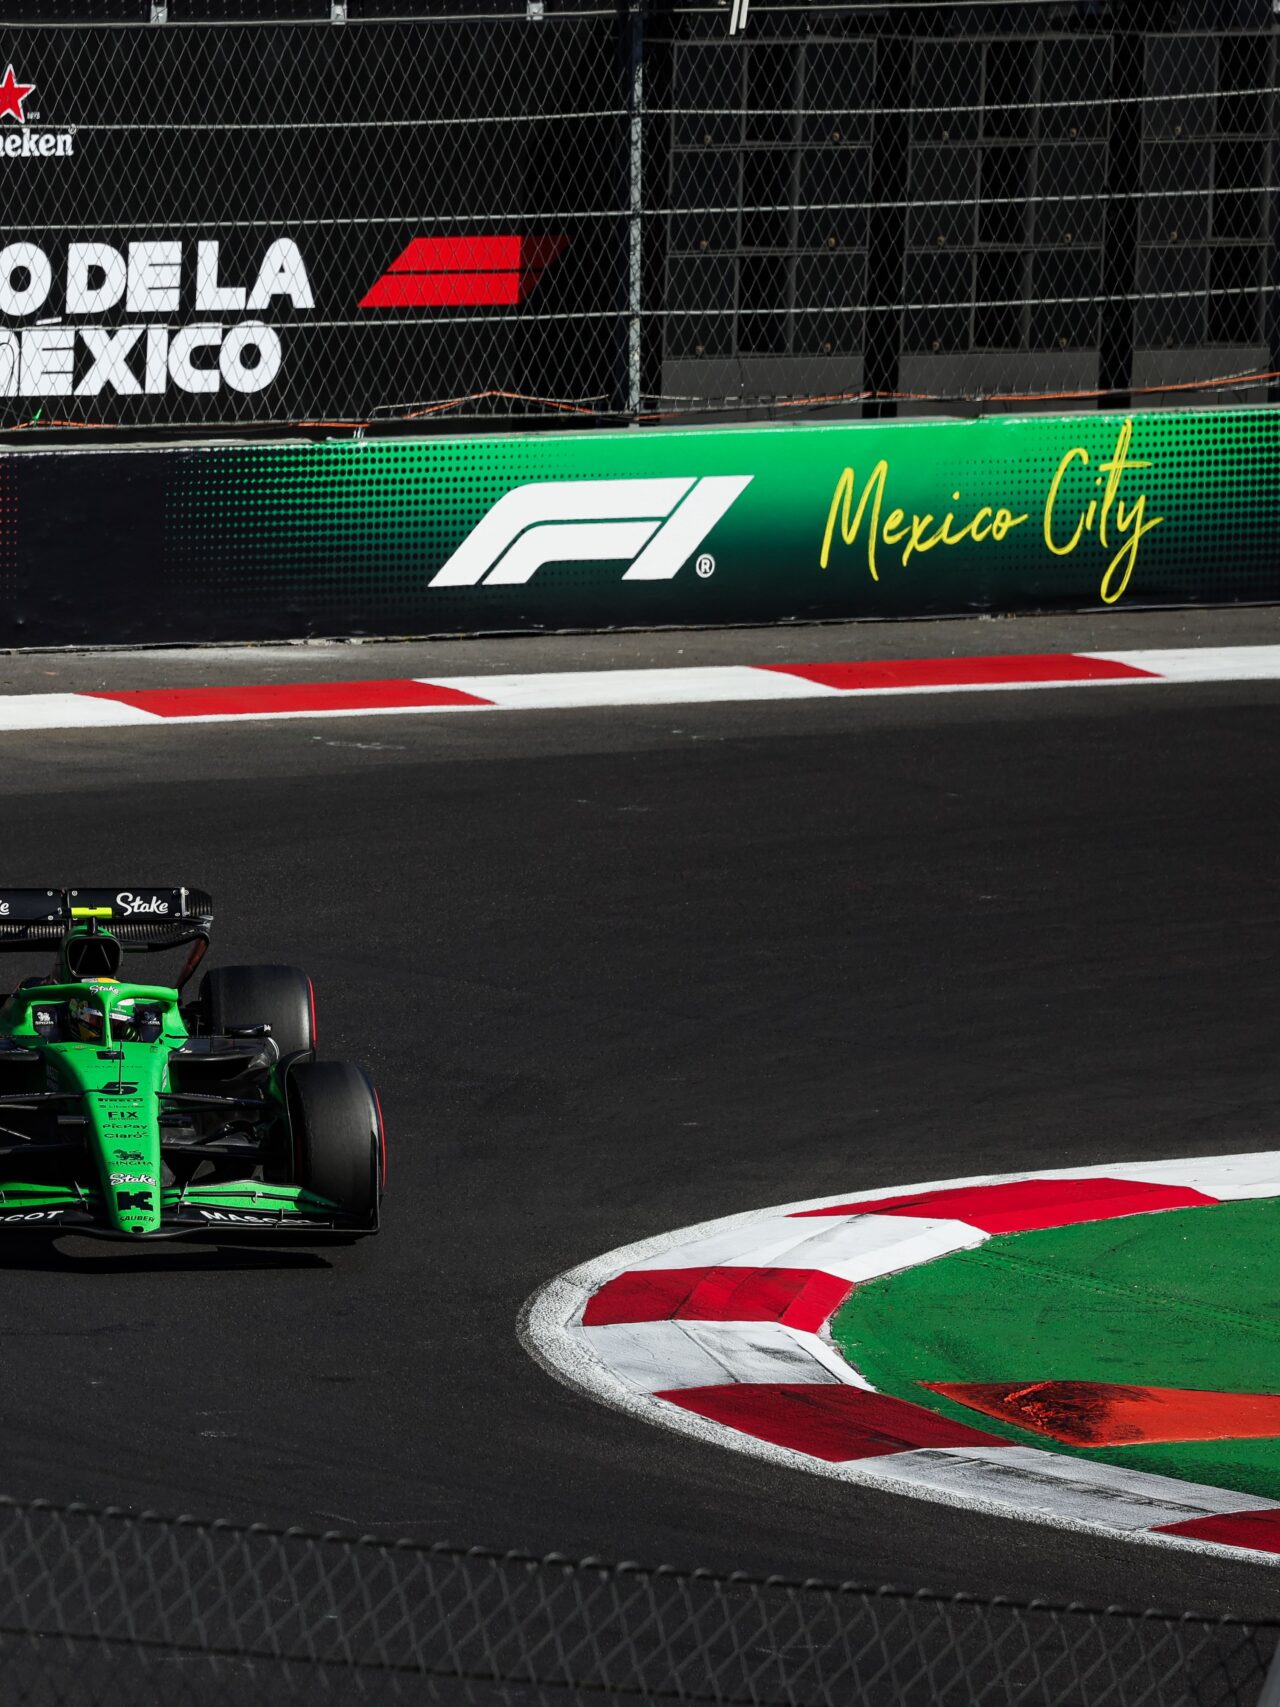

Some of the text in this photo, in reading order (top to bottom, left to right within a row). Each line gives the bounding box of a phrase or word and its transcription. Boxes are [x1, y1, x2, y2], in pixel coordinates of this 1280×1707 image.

[65, 241, 182, 314] DE
[195, 238, 315, 311] LA
[820, 418, 1163, 603] Mexico City
[116, 892, 169, 916] Stake
[89, 985, 120, 995] Stake
[109, 1172, 157, 1187] Stake
[119, 1215, 156, 1223] SAUBER
